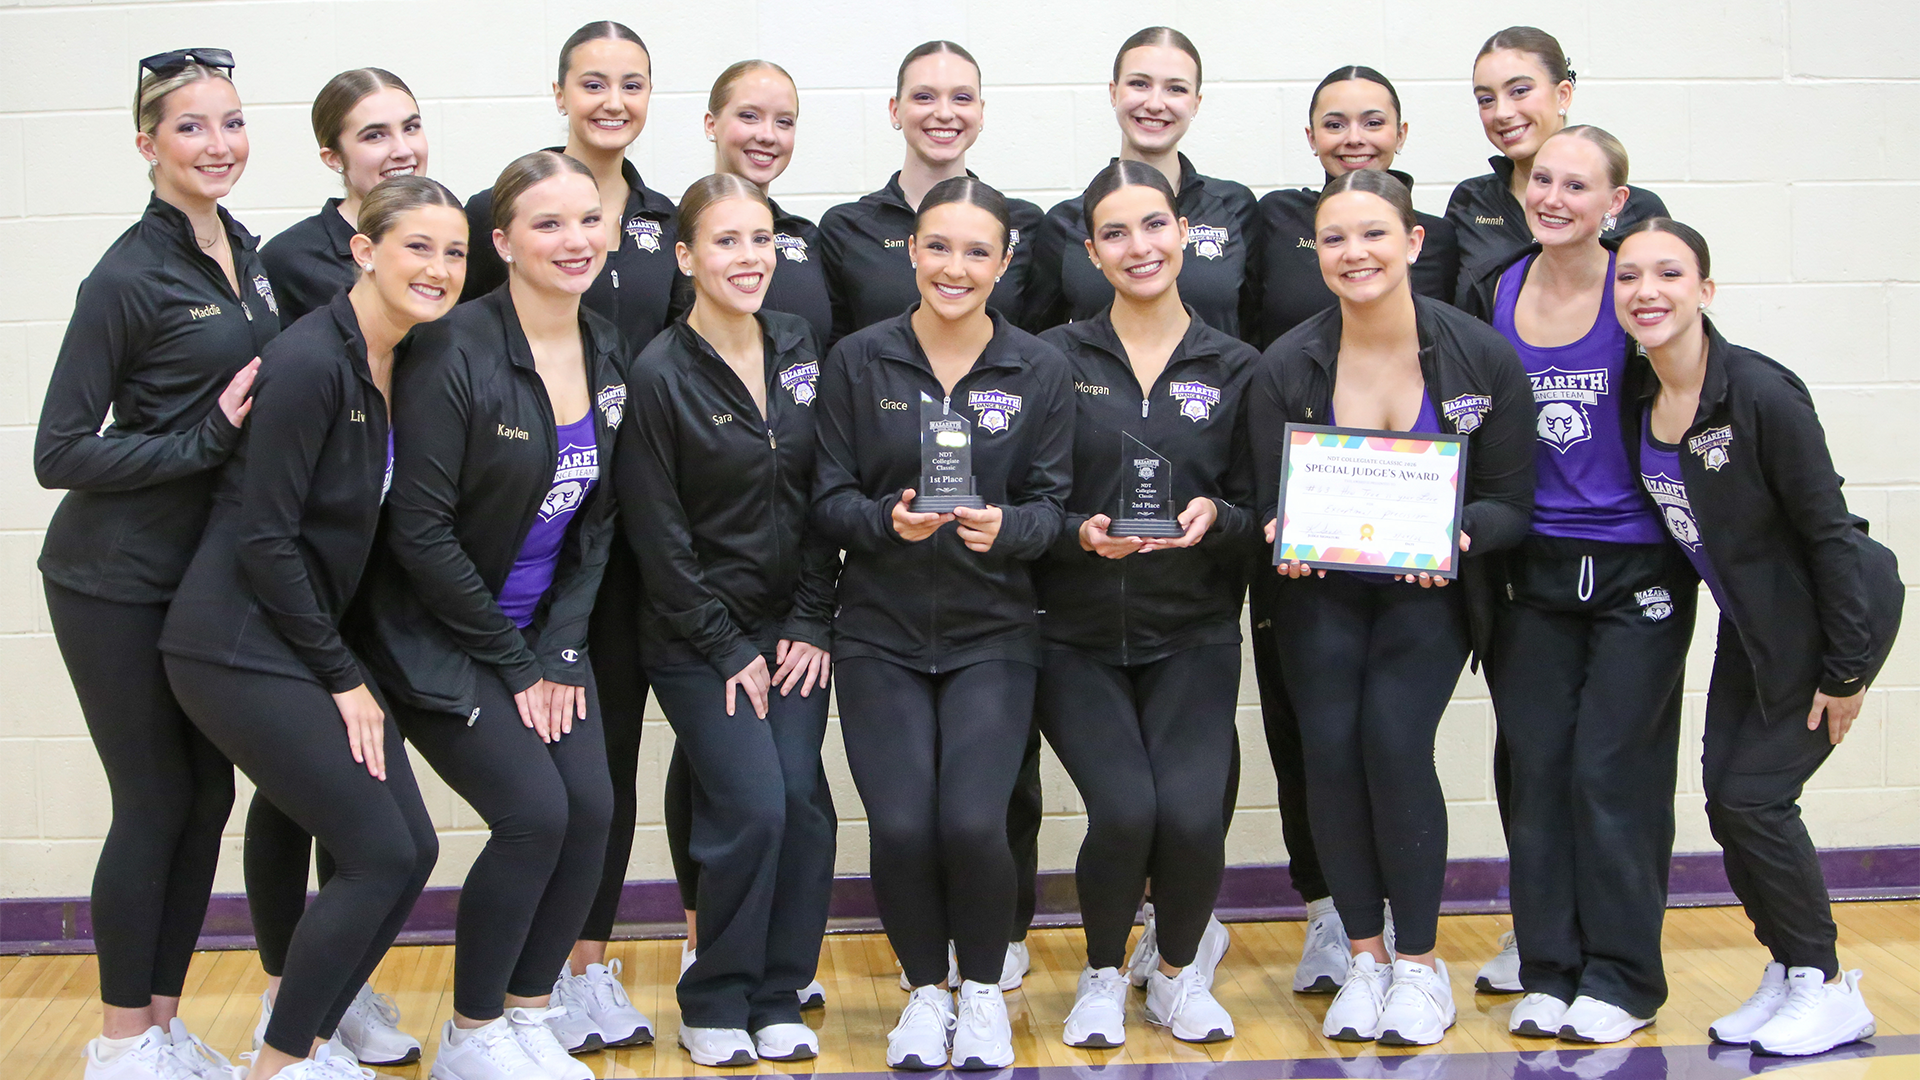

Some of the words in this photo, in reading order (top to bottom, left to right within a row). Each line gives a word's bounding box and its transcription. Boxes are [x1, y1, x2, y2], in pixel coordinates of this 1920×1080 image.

[1475, 215, 1504, 226] Hannah
[884, 238, 905, 249] Sam
[189, 303, 221, 320] Maddie
[780, 363, 819, 386] NAZARETH
[1074, 381, 1110, 396] Morgan
[1172, 383, 1220, 401] NAZARETH
[1561, 391, 1585, 399] TEAM
[880, 398, 908, 411] Grace
[970, 393, 1021, 409] NAZARETH
[1444, 397, 1490, 414] NAZARETH
[712, 413, 733, 426] Sara
[497, 423, 529, 441] Kaylen
[1690, 428, 1732, 450] NAZARETH
[932, 458, 960, 466] Collegiate
[1341, 456, 1378, 465] COLLEGIATE
[1379, 459, 1403, 467] CLASSIC
[574, 468, 595, 477] TEAM
[930, 475, 941, 483] 1st
[942, 475, 963, 483] Place
[1304, 463, 1350, 475] SPECIAL
[1351, 467, 1397, 478] JUDGE'S
[1398, 470, 1440, 482] AWARD
